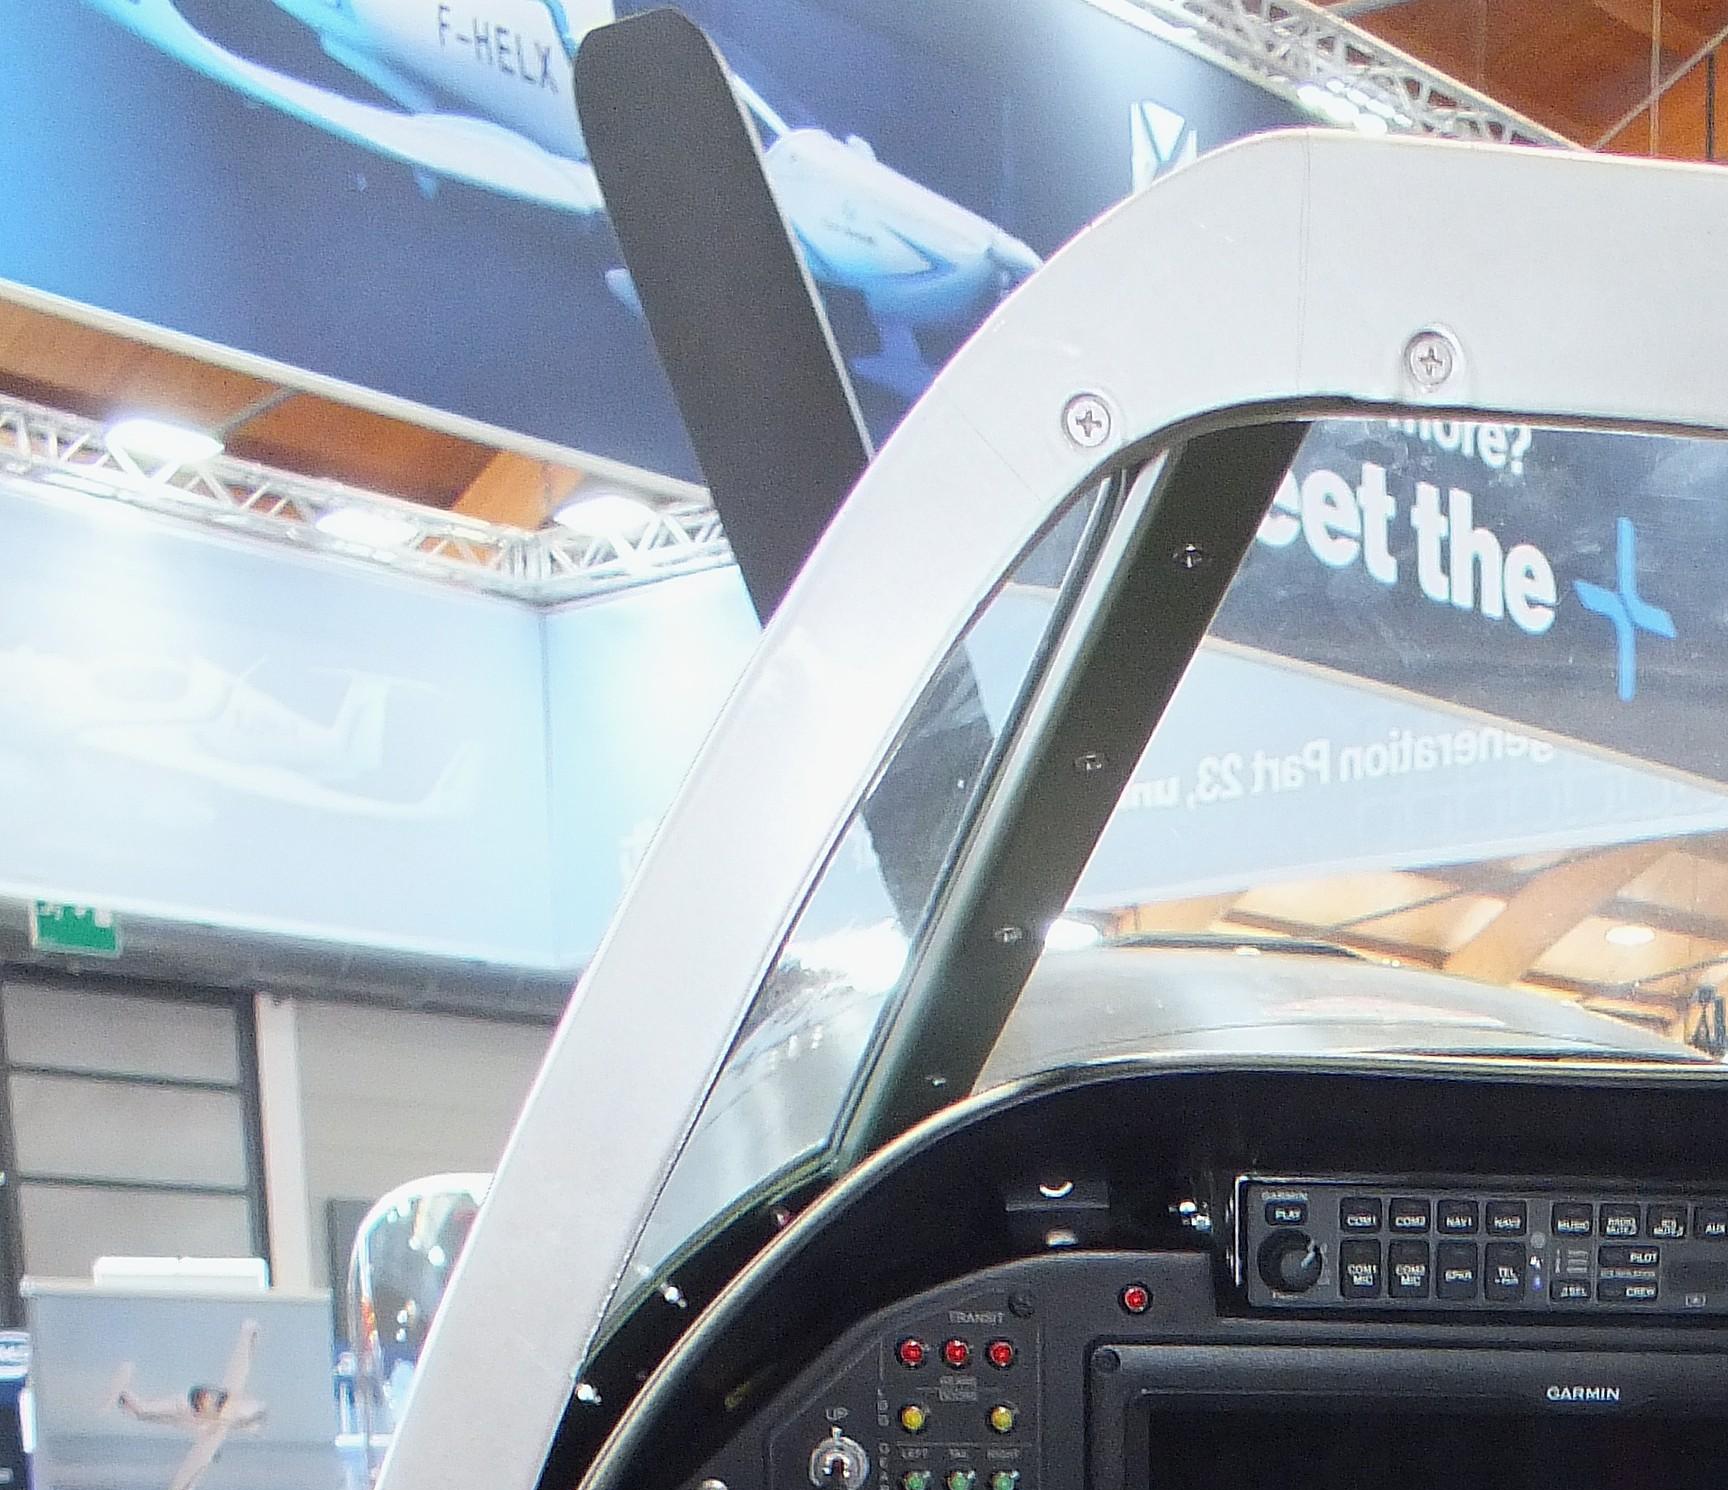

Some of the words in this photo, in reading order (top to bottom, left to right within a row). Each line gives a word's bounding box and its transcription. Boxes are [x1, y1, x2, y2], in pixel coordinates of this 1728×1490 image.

[438, 2, 560, 96] F-HELX
[1256, 462, 1397, 584] eet
[1411, 480, 1557, 635] the
[1275, 1208, 1302, 1220] PLAY
[1705, 1223, 1726, 1235] AUX
[1629, 1252, 1658, 1263] PILOT
[1625, 1286, 1656, 1298] CREW
[949, 1311, 1005, 1325] TRANSIT
[1546, 1385, 1621, 1401] GARMIN
[825, 1406, 849, 1421] UP
